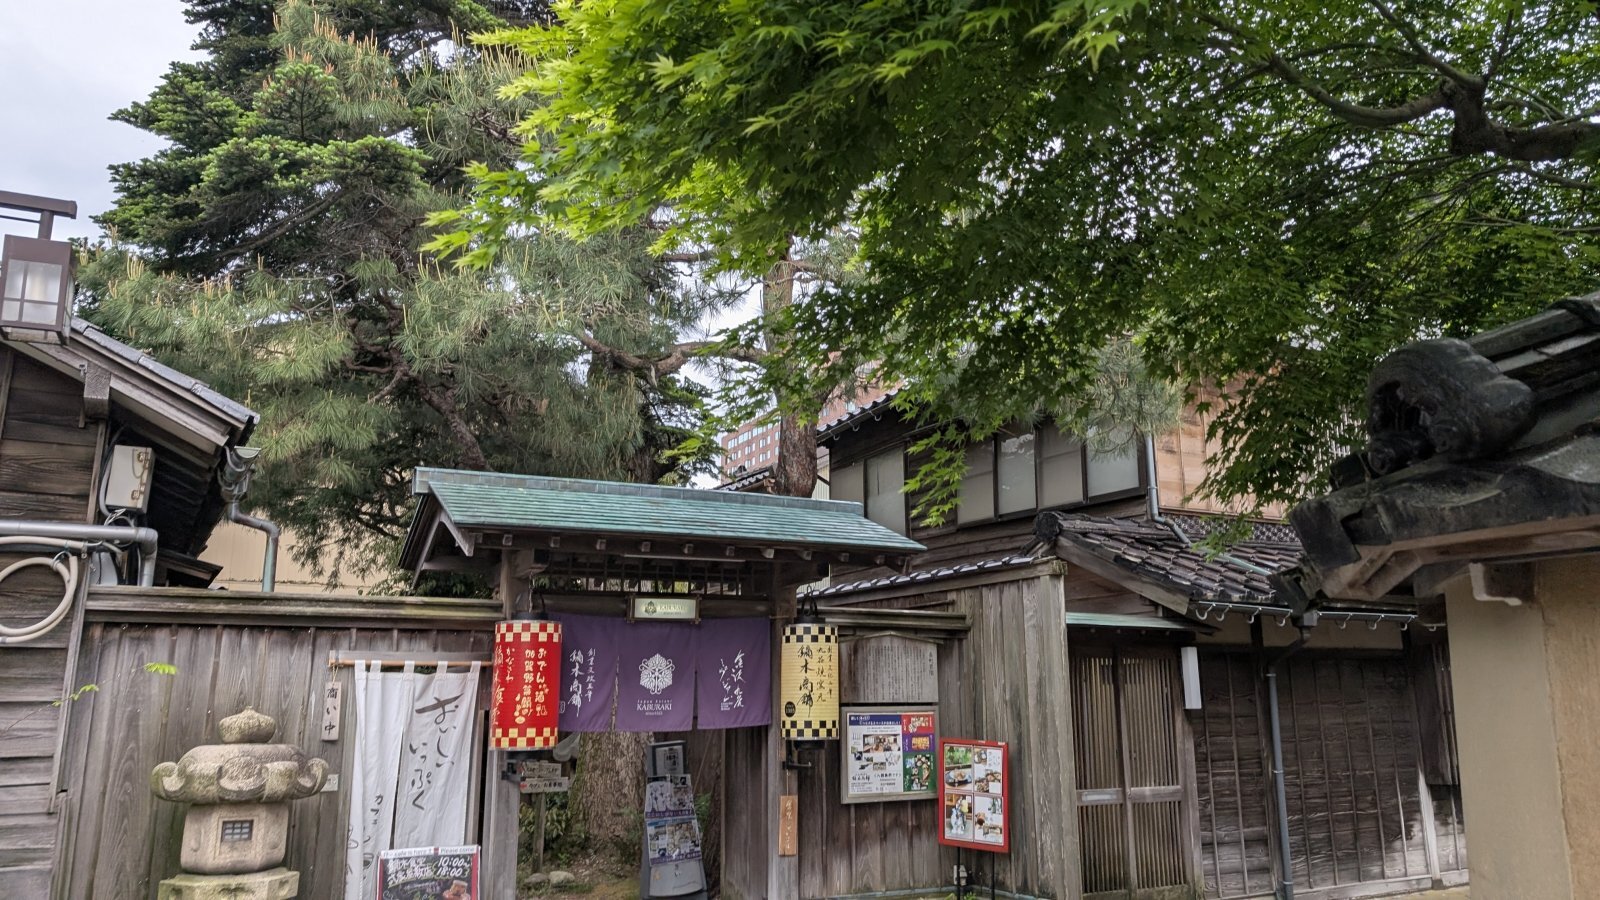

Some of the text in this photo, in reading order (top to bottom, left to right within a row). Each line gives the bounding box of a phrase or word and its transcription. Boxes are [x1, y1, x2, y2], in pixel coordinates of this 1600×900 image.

[325, 687, 338, 735] 商い中
[636, 703, 672, 711] KABURAKI
[415, 693, 464, 768] おいしい
[370, 794, 384, 825] カフェ
[437, 866, 463, 877] 18:00
